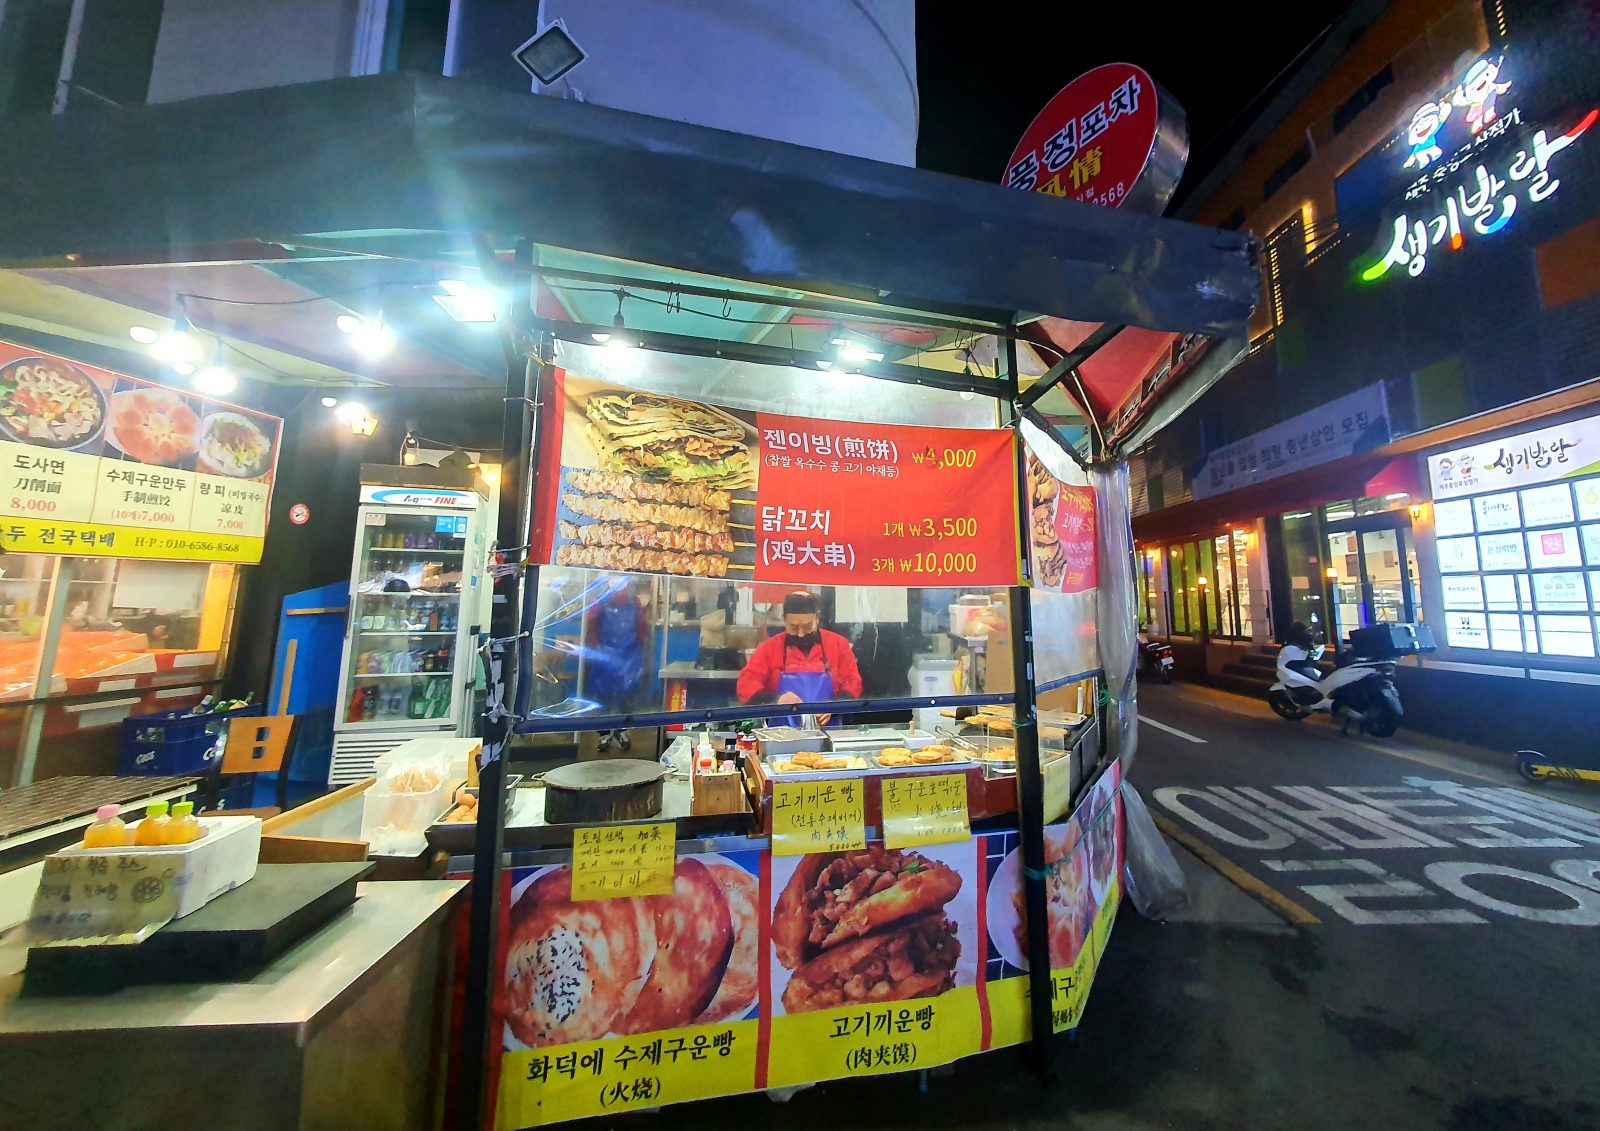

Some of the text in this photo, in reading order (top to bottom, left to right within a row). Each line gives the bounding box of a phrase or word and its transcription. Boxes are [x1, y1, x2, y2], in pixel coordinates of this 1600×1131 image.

[1007, 75, 1141, 191] 풍정포차
[1362, 108, 1599, 281] 생기발랄
[1341, 411, 1369, 434] 모집
[14, 455, 65, 475] 도사면
[765, 454, 899, 479] (찹쌀 옥수수 콩 고기 야채등)
[1484, 438, 1583, 475] 생기발랄
[106, 469, 187, 491] 수제구운만두
[434, 496, 457, 505] FINE
[761, 506, 831, 535] 닭꼬치
[883, 520, 904, 538] 1개
[40, 527, 116, 548] 전국택배
[762, 538, 856, 571] (鸡大串)
[871, 556, 895, 574] 3개
[828, 1004, 936, 1040] 고기끼운빵
[526, 1031, 737, 1084] 화덕에 수제구운빵
[599, 1076, 663, 1107] (火烧)
